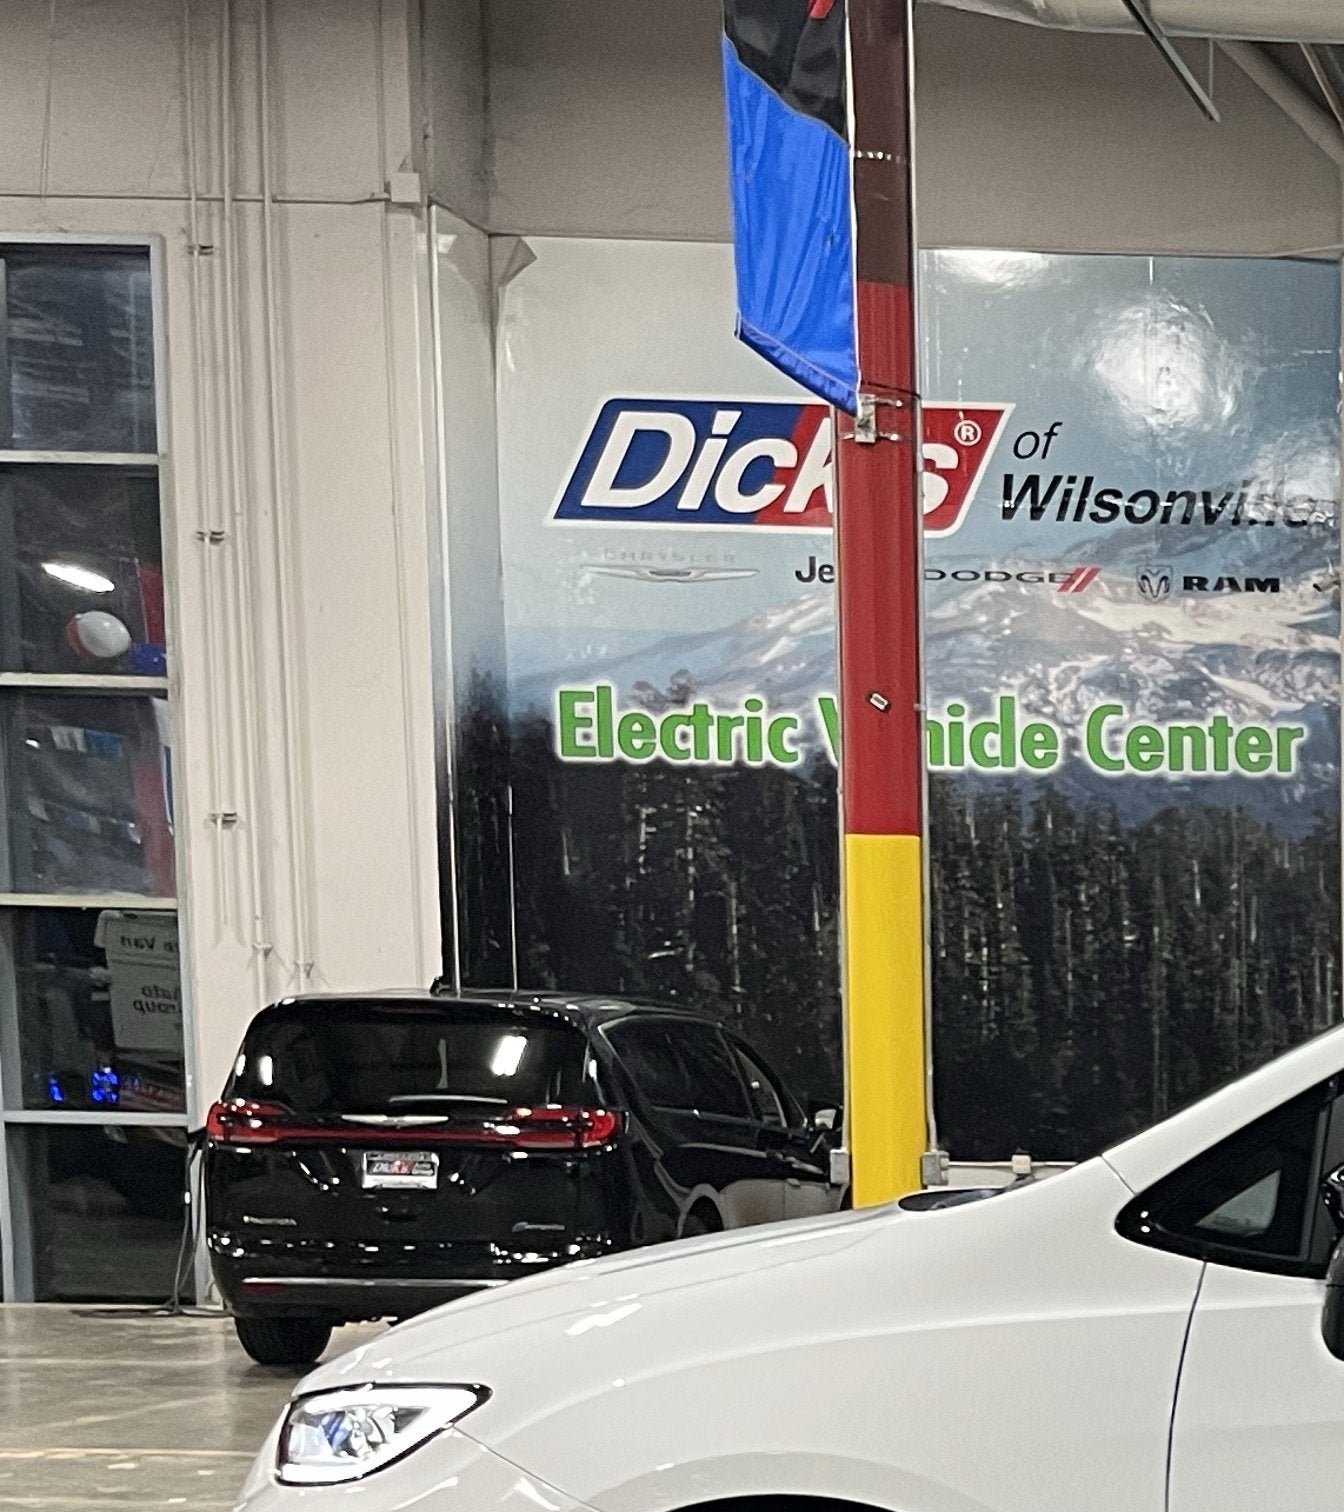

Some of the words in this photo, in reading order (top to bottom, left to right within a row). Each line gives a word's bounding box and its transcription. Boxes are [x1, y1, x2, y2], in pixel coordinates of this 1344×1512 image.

[1013, 422, 1063, 460] of
[1183, 576, 1281, 593] RAM
[559, 686, 800, 763] Electric
[1086, 704, 1304, 773] Center
